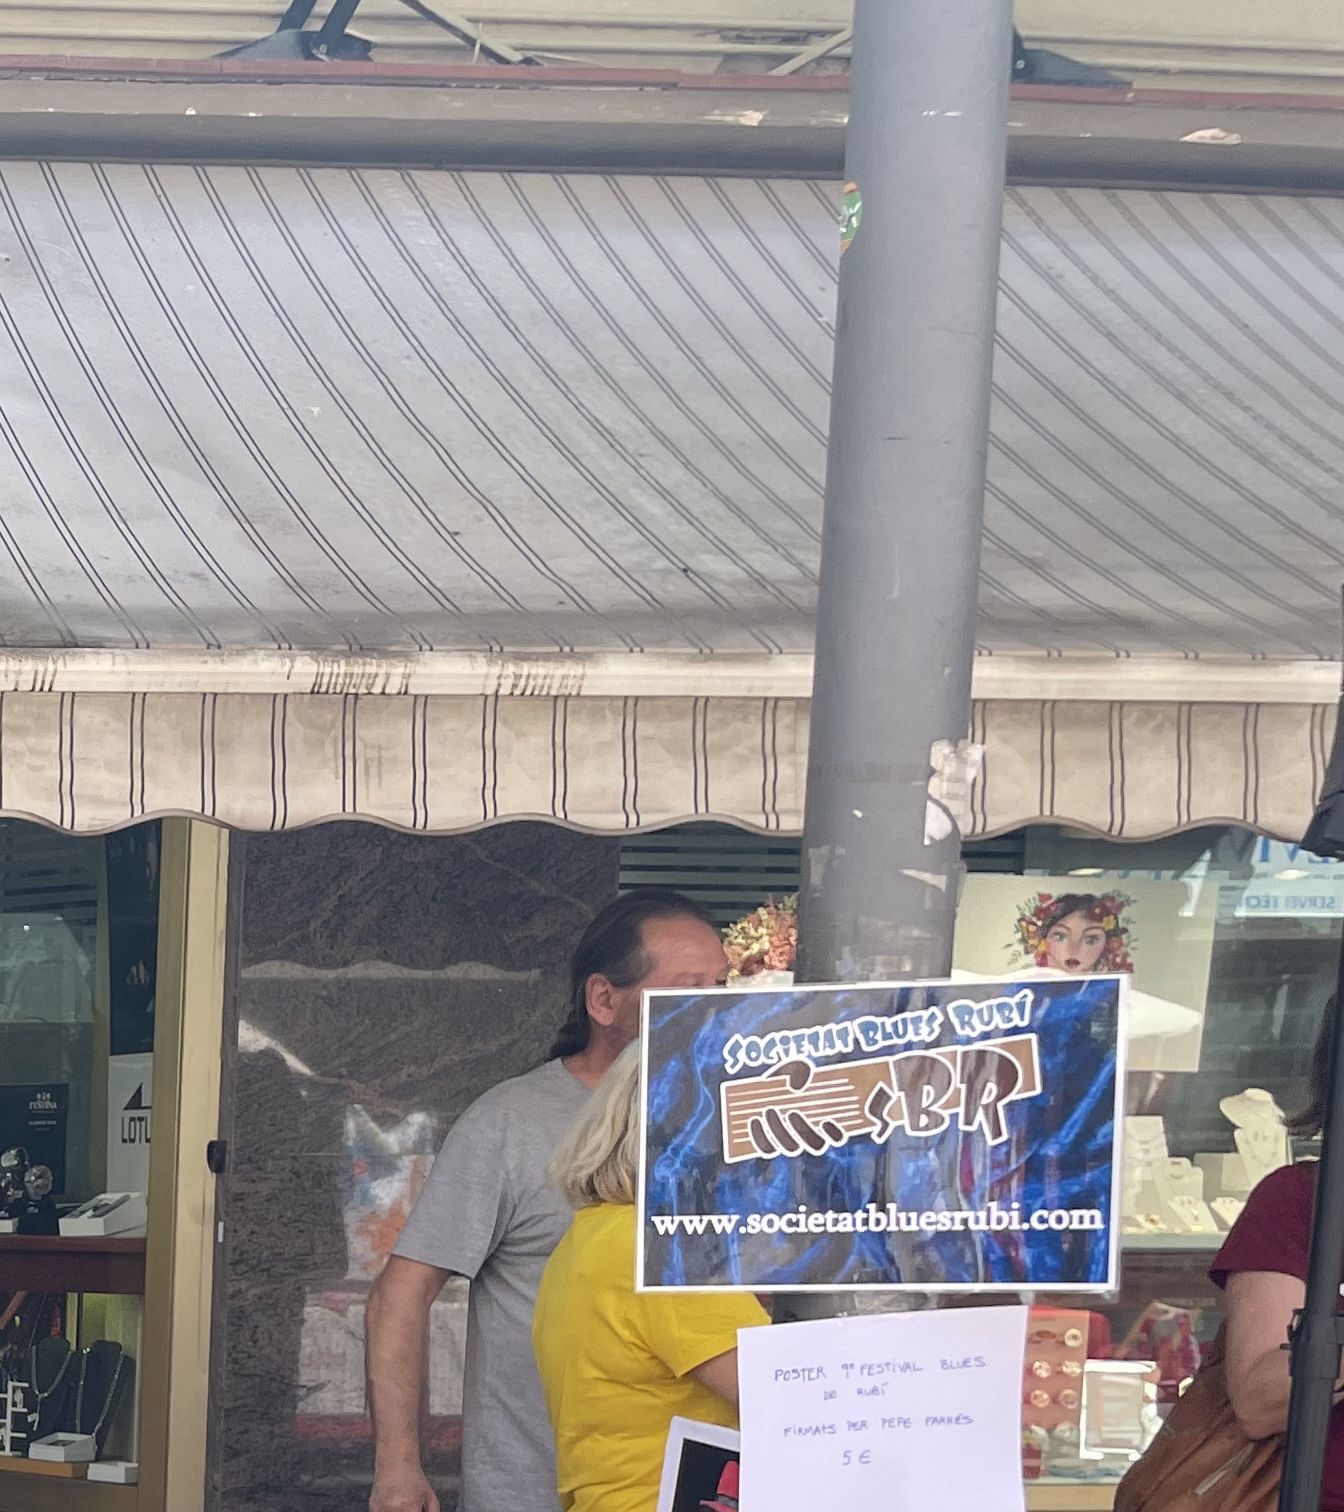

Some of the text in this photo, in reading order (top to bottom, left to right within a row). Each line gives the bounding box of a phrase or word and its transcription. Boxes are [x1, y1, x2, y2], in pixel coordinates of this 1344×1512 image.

[855, 1006, 944, 1053] BLUES
[651, 1202, 1105, 1236] www.societatbluesrubi.com
[774, 1366, 827, 1382] POSTER
[939, 1355, 987, 1370] BLUES
[823, 1390, 838, 1401] DE
[846, 1419, 868, 1432] PER
